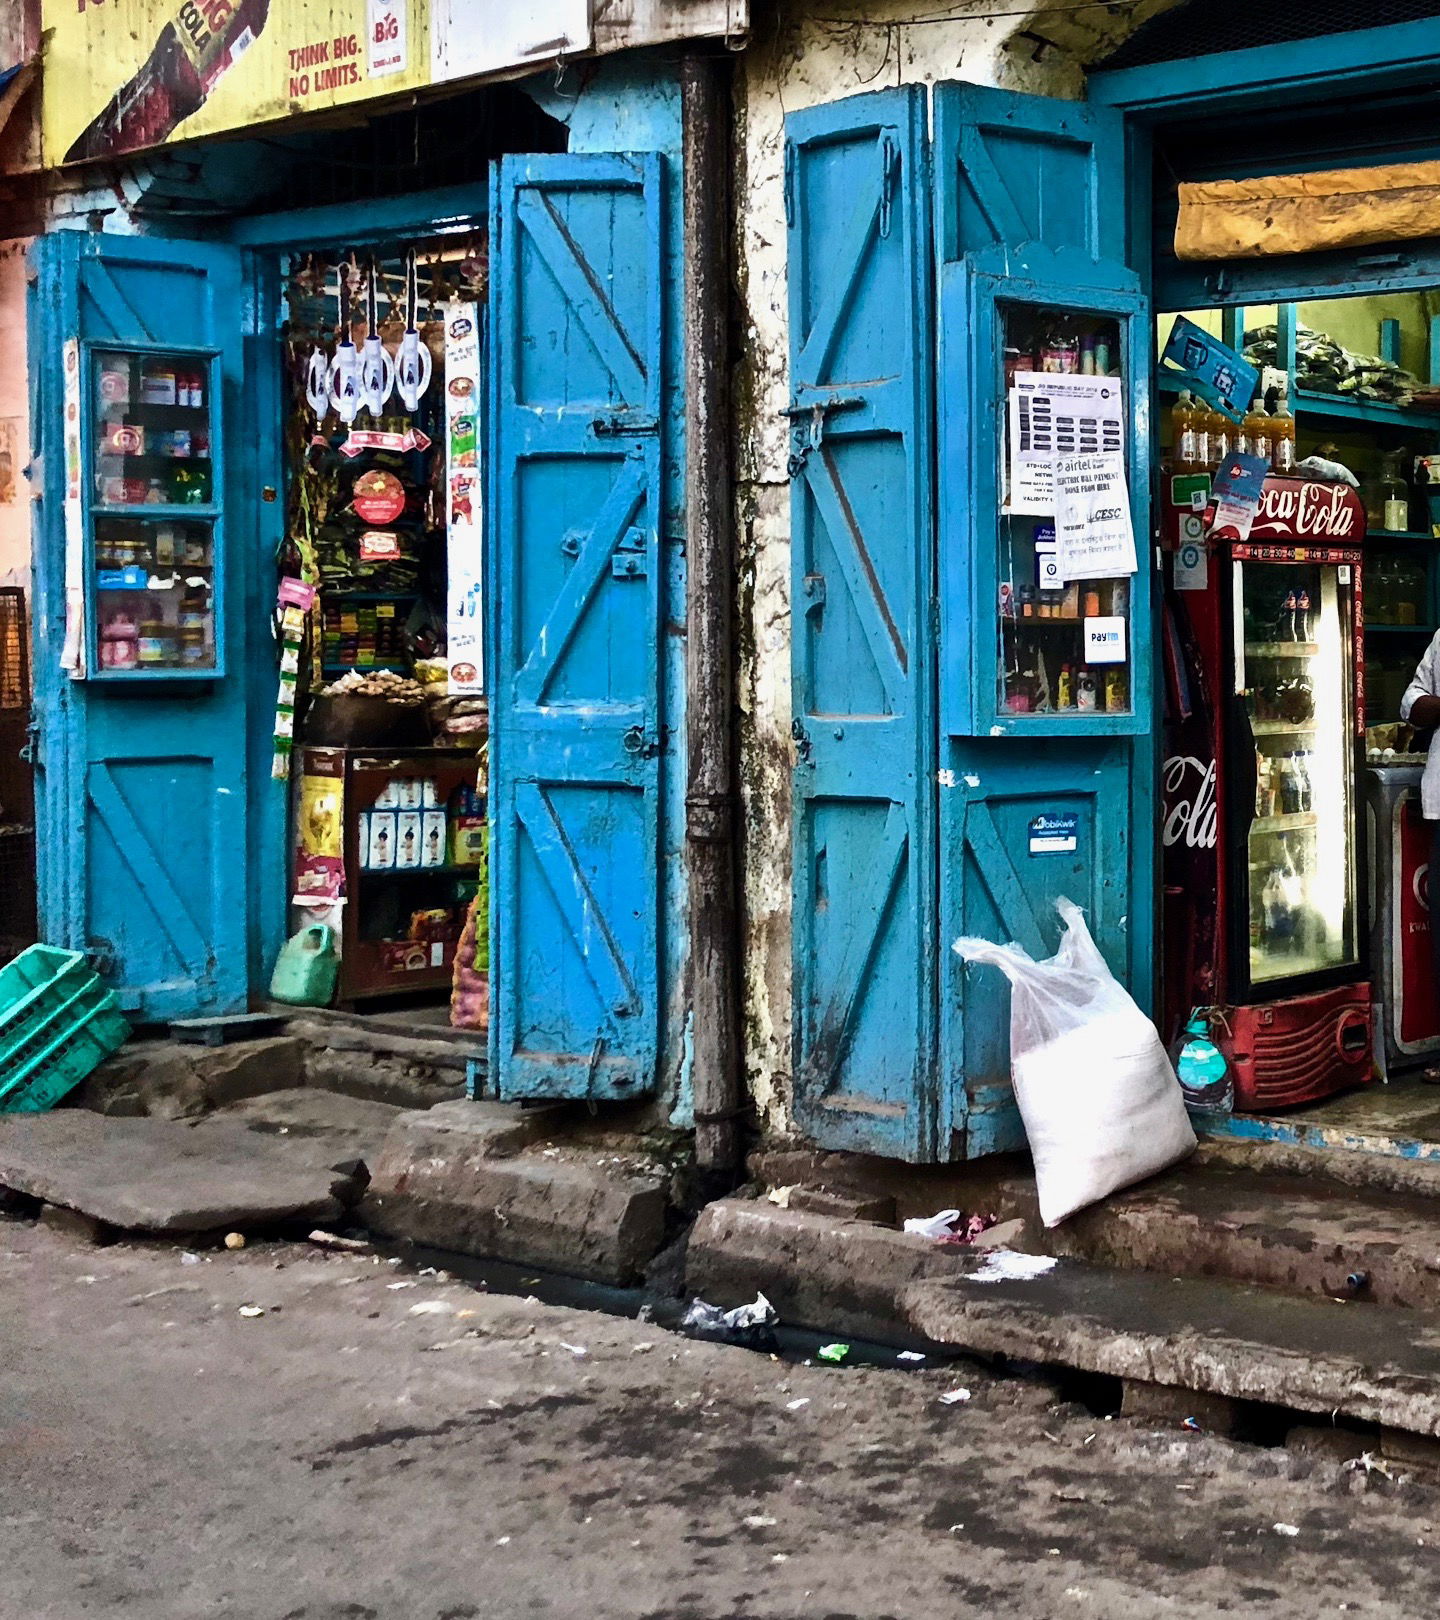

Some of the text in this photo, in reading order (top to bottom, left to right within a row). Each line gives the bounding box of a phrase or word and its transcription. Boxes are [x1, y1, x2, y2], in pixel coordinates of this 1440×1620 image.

[288, 34, 362, 72] THINK BIG.
[289, 62, 363, 98] NO LIMITS.
[1065, 459, 1092, 473] airtel
[1095, 507, 1122, 520] CESC
[1255, 482, 1355, 536] oca-Cola
[1409, 921, 1431, 934] KWAL
